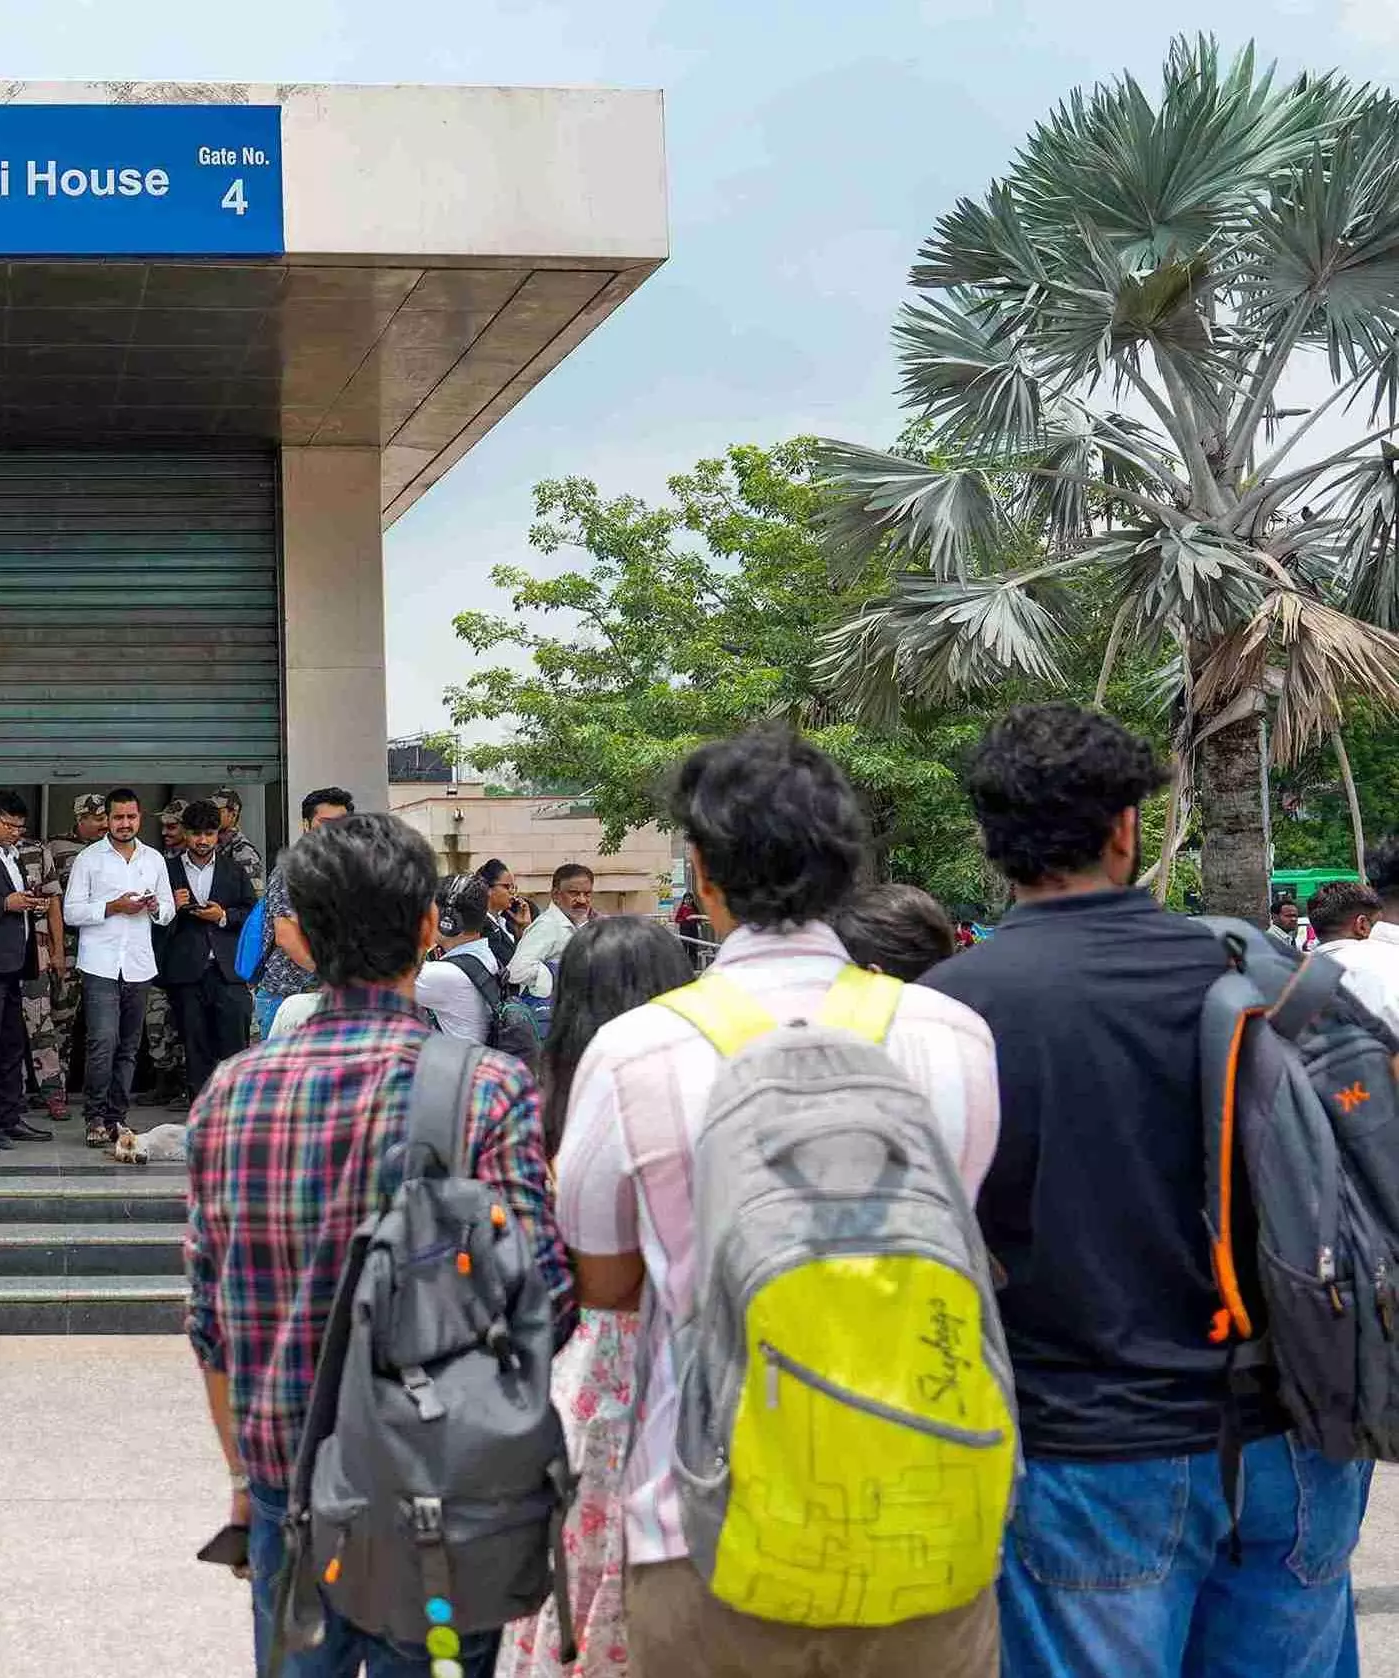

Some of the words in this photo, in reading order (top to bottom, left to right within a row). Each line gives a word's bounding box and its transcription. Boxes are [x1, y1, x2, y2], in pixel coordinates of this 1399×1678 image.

[198, 146, 236, 166] Gate
[242, 147, 270, 166] No.
[26, 160, 170, 197] House
[221, 178, 248, 215] 4
